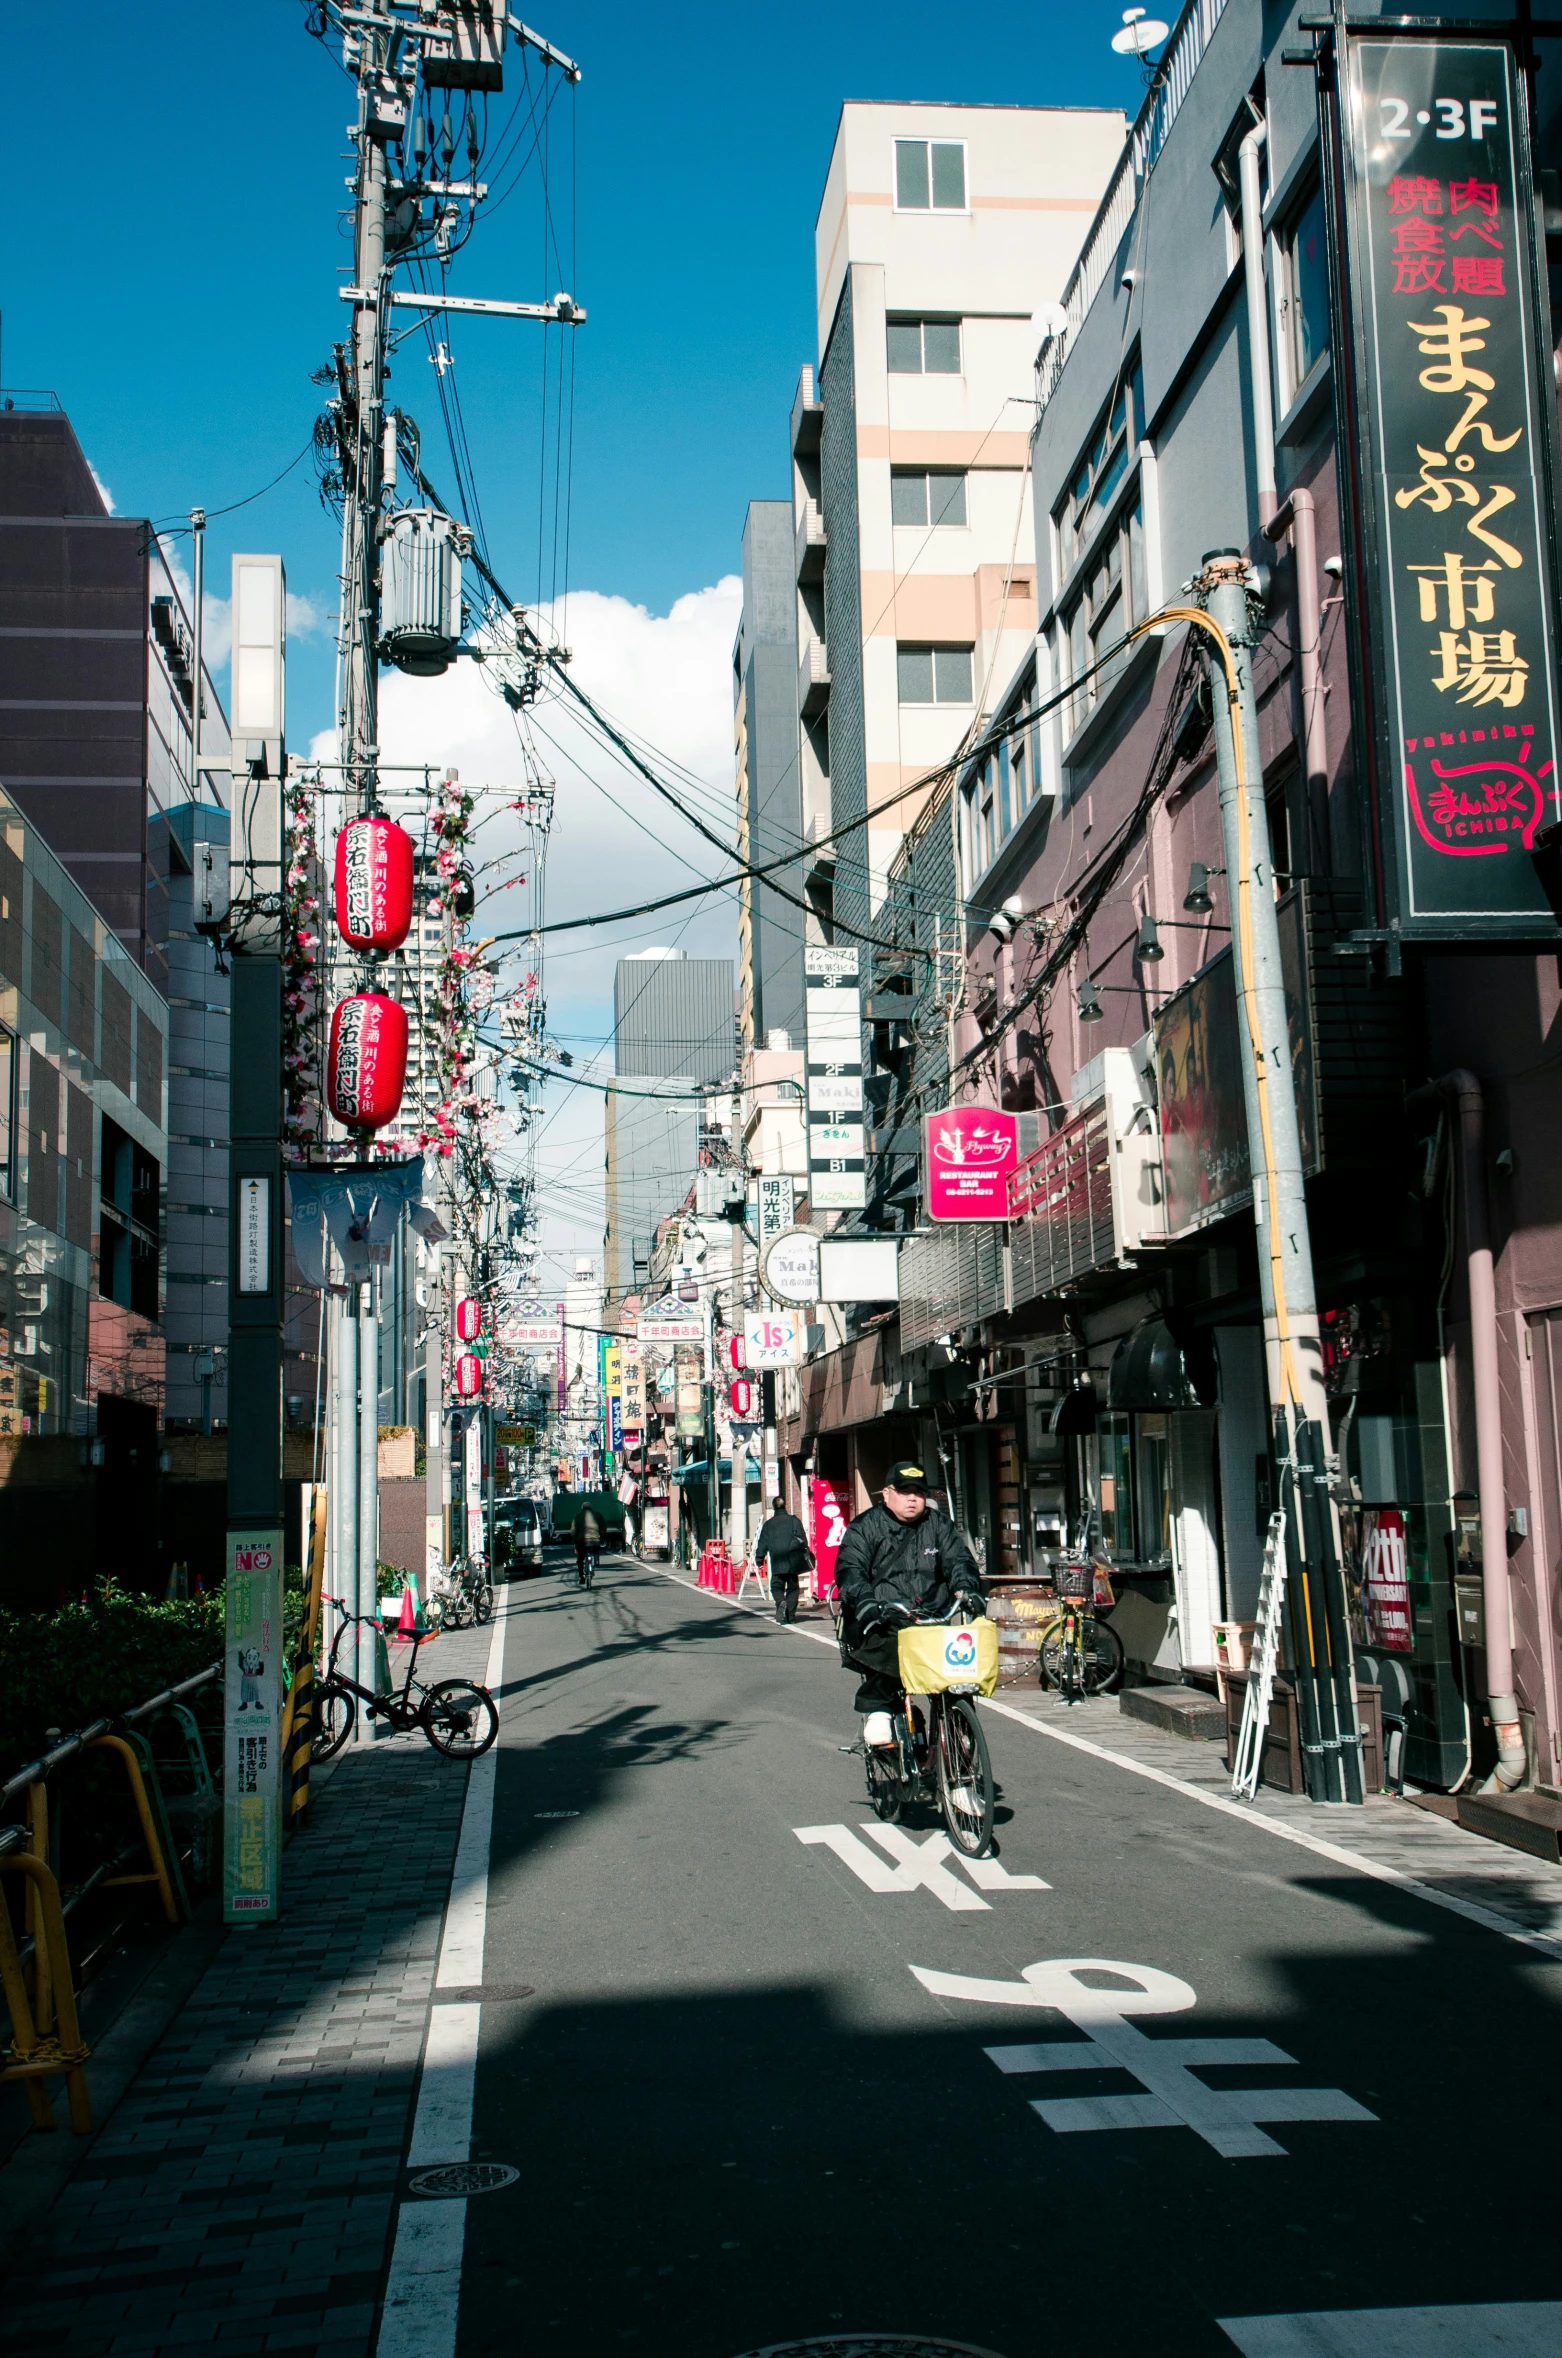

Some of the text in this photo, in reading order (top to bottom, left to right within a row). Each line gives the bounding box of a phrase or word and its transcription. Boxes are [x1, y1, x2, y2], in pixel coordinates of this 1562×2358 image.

[1386, 176, 1499, 216] 焼肉
[1389, 216, 1504, 255] 食べ
[1391, 256, 1507, 296] 放題
[1394, 304, 1530, 708] まんぷく市場
[1405, 725, 1535, 753] yakiniku
[1427, 780, 1529, 823] まんぷく
[1445, 818, 1524, 838] ICHIBA
[346, 822, 372, 938] 宗右衛門町
[823, 975, 843, 988] 3F
[335, 998, 366, 1118] 宗右衛門町
[825, 1063, 845, 1077] 2F
[817, 1086, 860, 1098] Maki
[828, 1111, 845, 1124] 1F
[830, 1160, 846, 1172] B1
[939, 1171, 998, 1180] RESTAURANT
[959, 1179, 979, 1188] BAR
[782, 1179, 791, 1229] インペリア
[248, 1196, 259, 1291] 日本街路灯製造株式会社
[641, 1326, 700, 1337] 千年町商店会
[762, 1321, 783, 1348] Is
[759, 1350, 790, 1358] アイス
[526, 1428, 534, 1441] P
[246, 1737, 258, 1792] 客引き行為
[258, 1736, 268, 1770] 路上での
